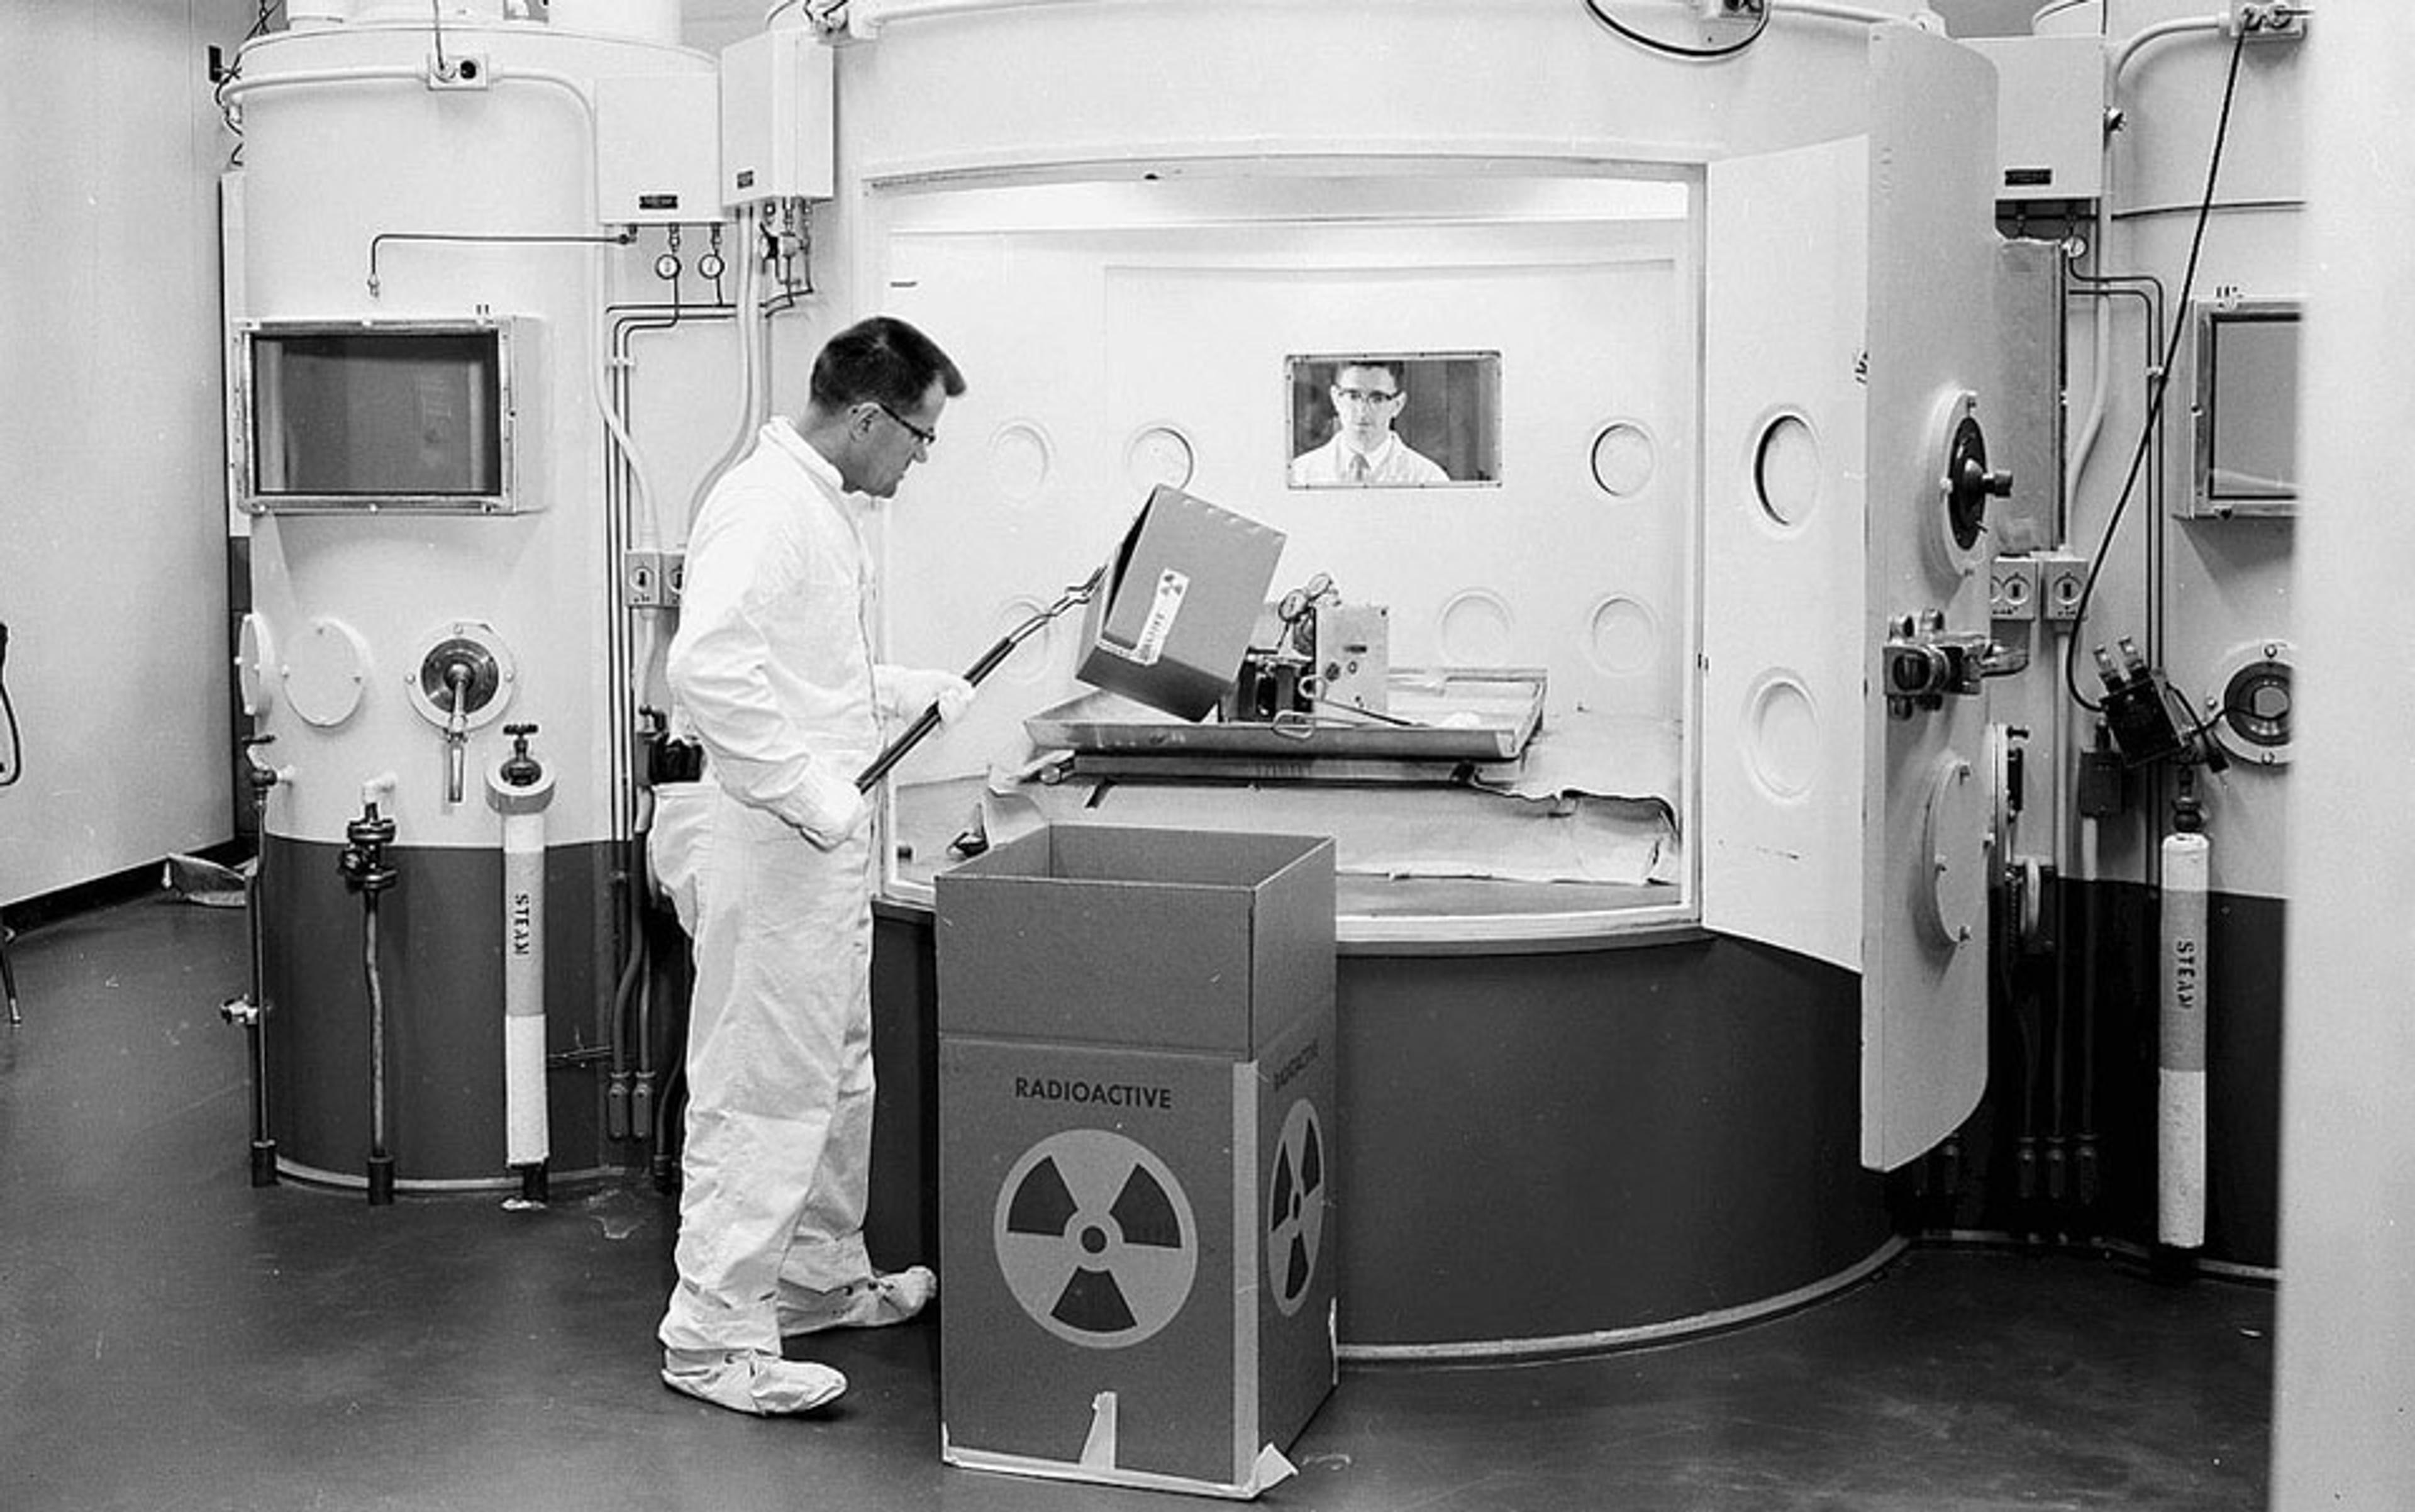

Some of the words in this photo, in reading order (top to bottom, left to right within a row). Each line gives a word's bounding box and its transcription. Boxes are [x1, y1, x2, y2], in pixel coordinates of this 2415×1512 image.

[514, 894, 530, 955] STEAM
[2177, 940, 2195, 1009] STEAM
[1015, 1076, 1172, 1109] RADIOACTIVE
